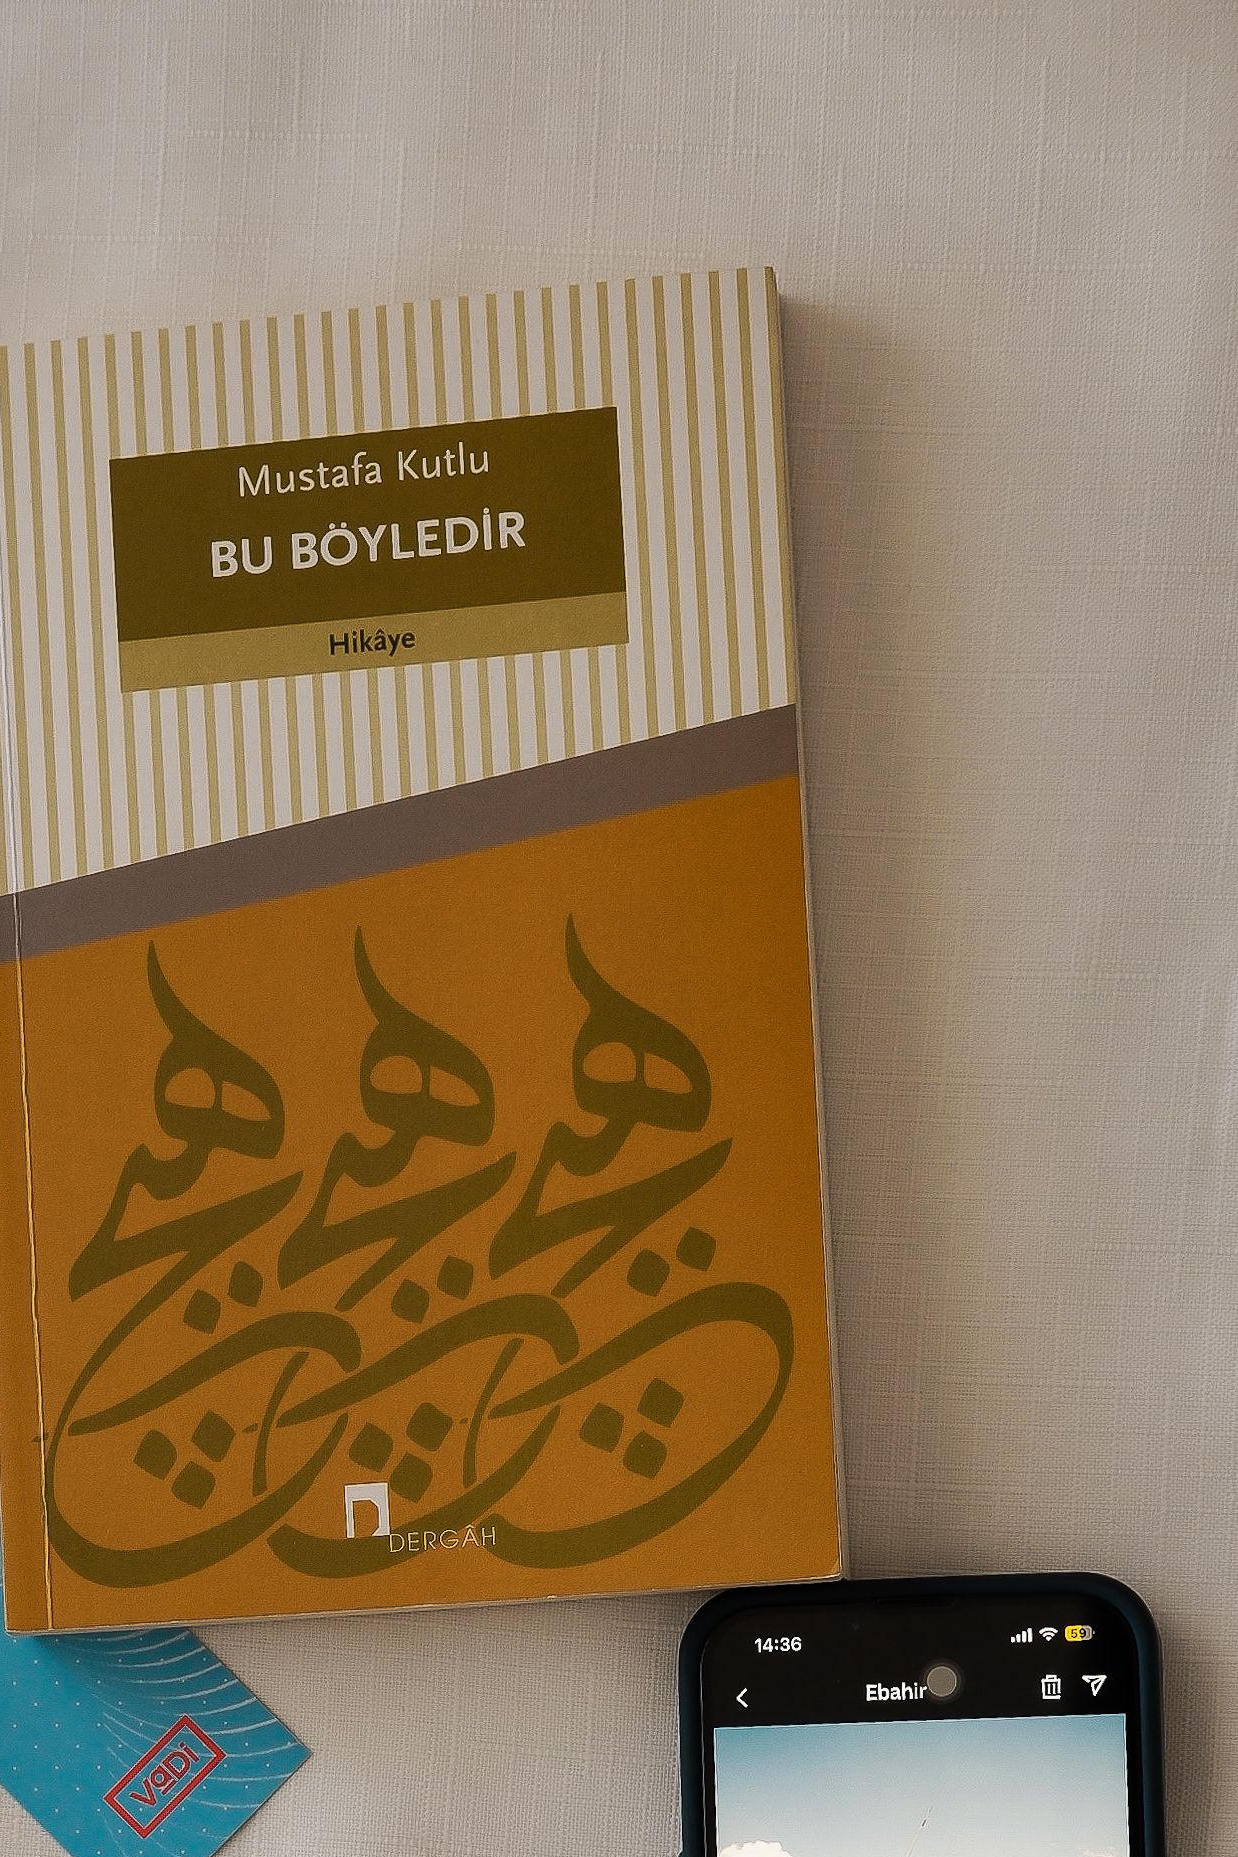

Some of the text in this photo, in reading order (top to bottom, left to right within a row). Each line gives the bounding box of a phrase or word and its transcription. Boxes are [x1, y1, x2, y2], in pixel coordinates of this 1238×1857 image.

[237, 441, 490, 499] Mustafa Kutlu
[210, 507, 527, 578] BU BÖYLEDİR
[328, 628, 417, 658] Hikâye
[389, 1524, 497, 1554] DERGÂH
[754, 1627, 1087, 1654] 14:36 59
[865, 1683, 928, 1703] Ebahir
